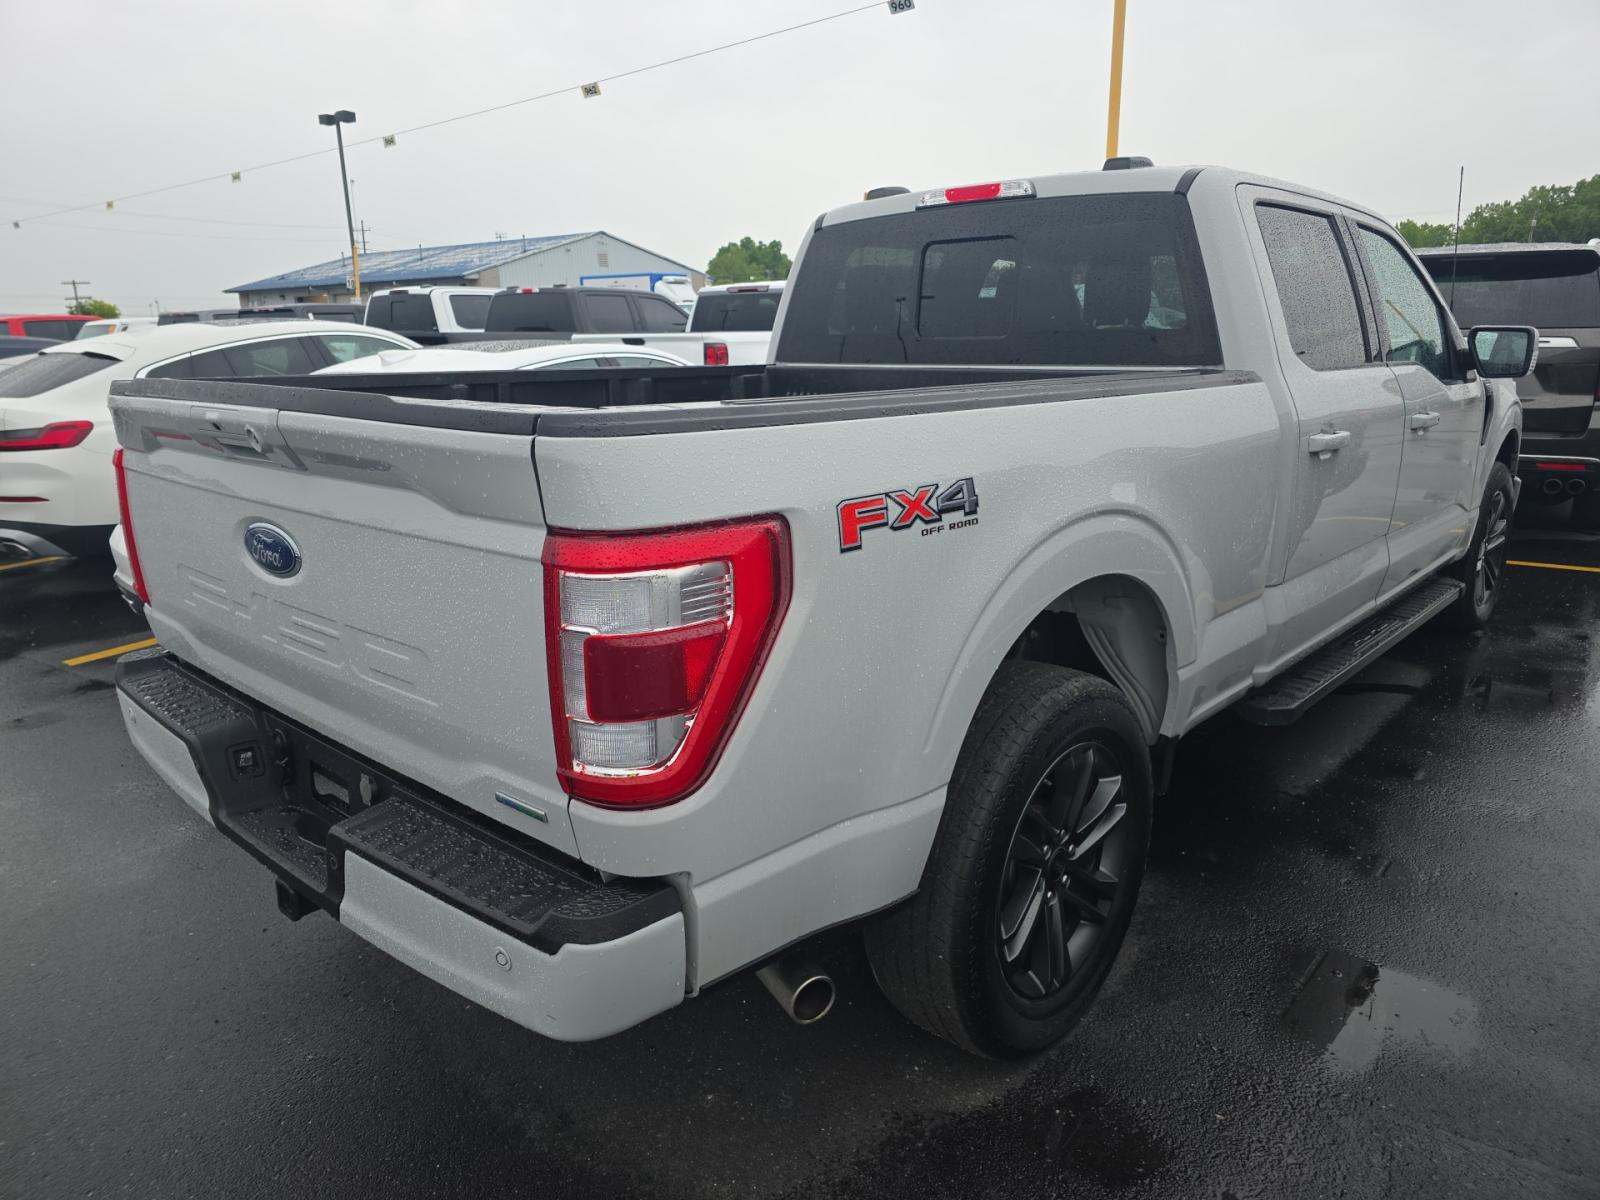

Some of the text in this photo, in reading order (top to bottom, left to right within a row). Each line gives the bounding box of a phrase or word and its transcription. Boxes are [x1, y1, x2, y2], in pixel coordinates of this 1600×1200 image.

[890, 0, 912, 12] 960
[836, 477, 979, 554] FX4
[921, 517, 979, 537] OFF ROAD
[250, 532, 284, 568] Ford
